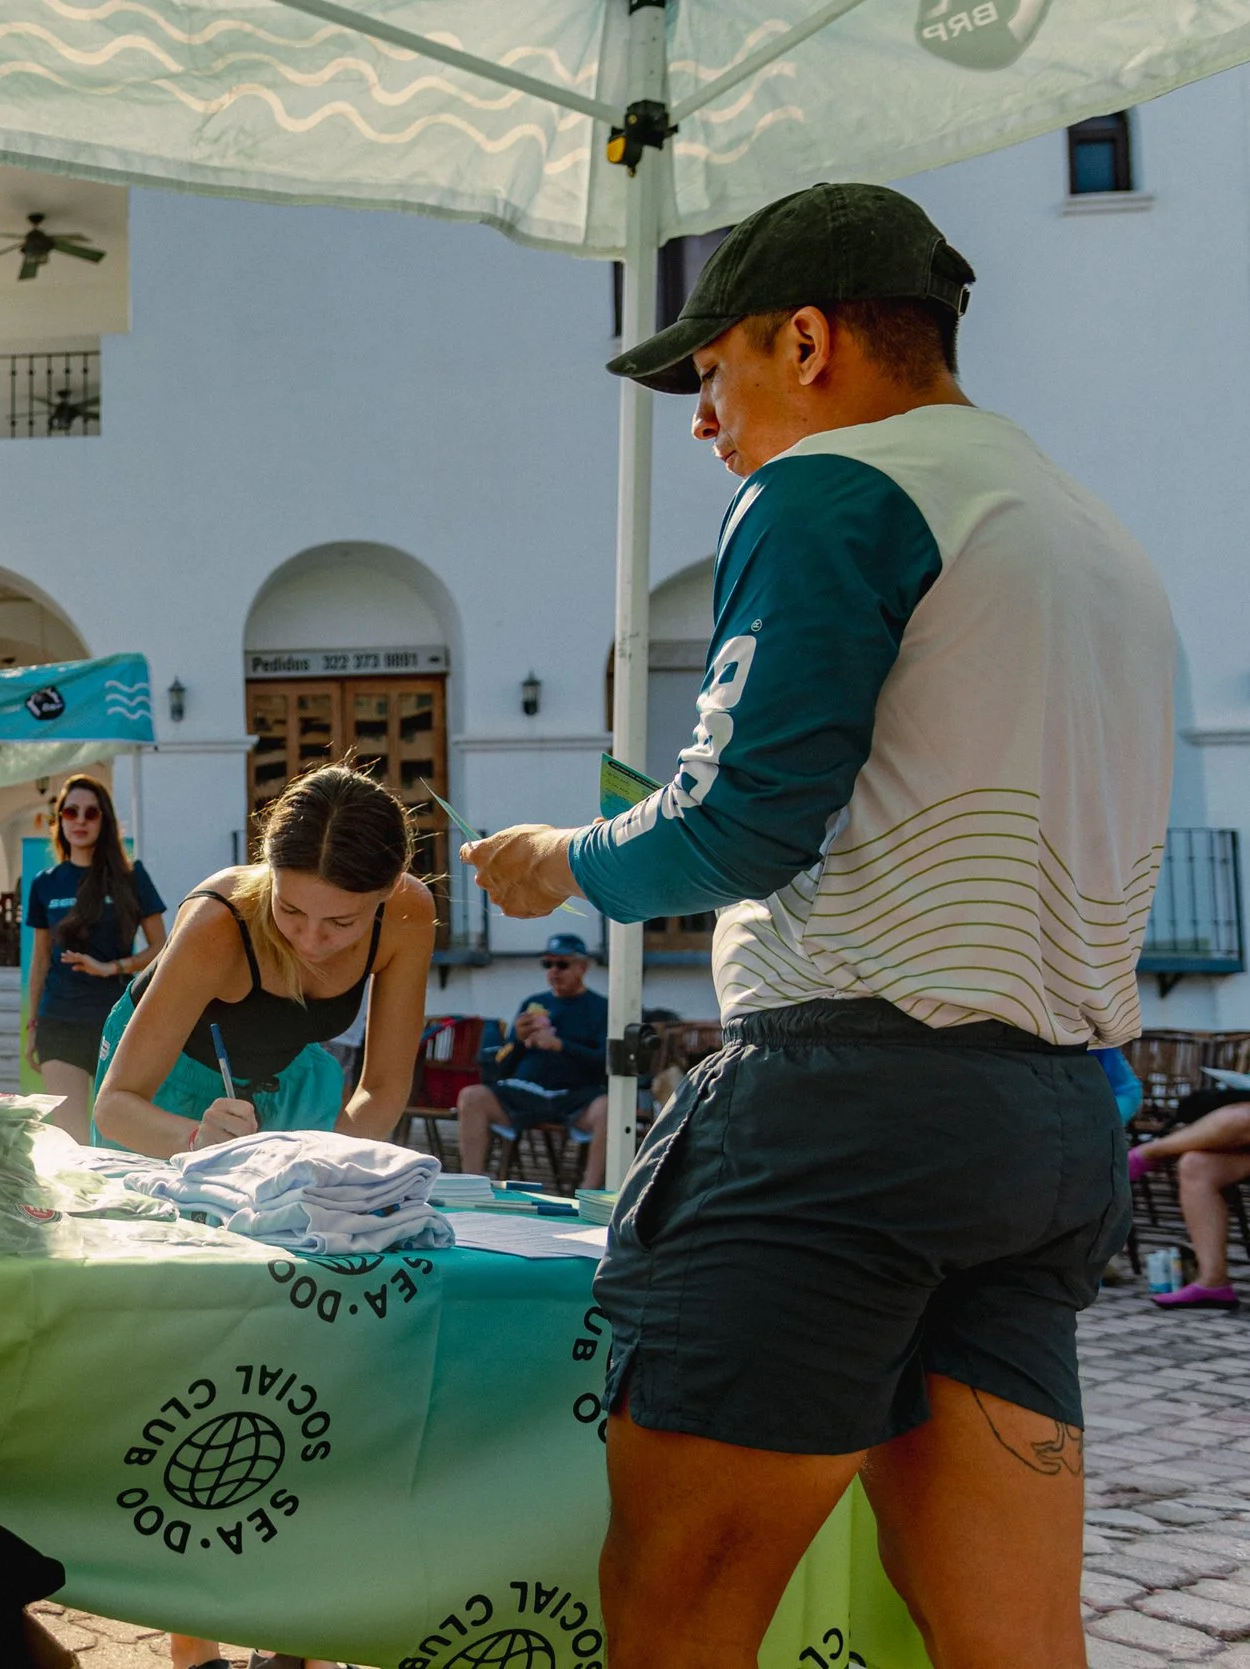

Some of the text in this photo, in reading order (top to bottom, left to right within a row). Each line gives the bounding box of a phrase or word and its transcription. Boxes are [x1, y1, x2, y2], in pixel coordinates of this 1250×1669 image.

[323, 655, 350, 670] 322
[123, 1378, 217, 1466] CLUB
[235, 1364, 331, 1462] SOCIAL
[509, 1581, 603, 1669] OCIAL
